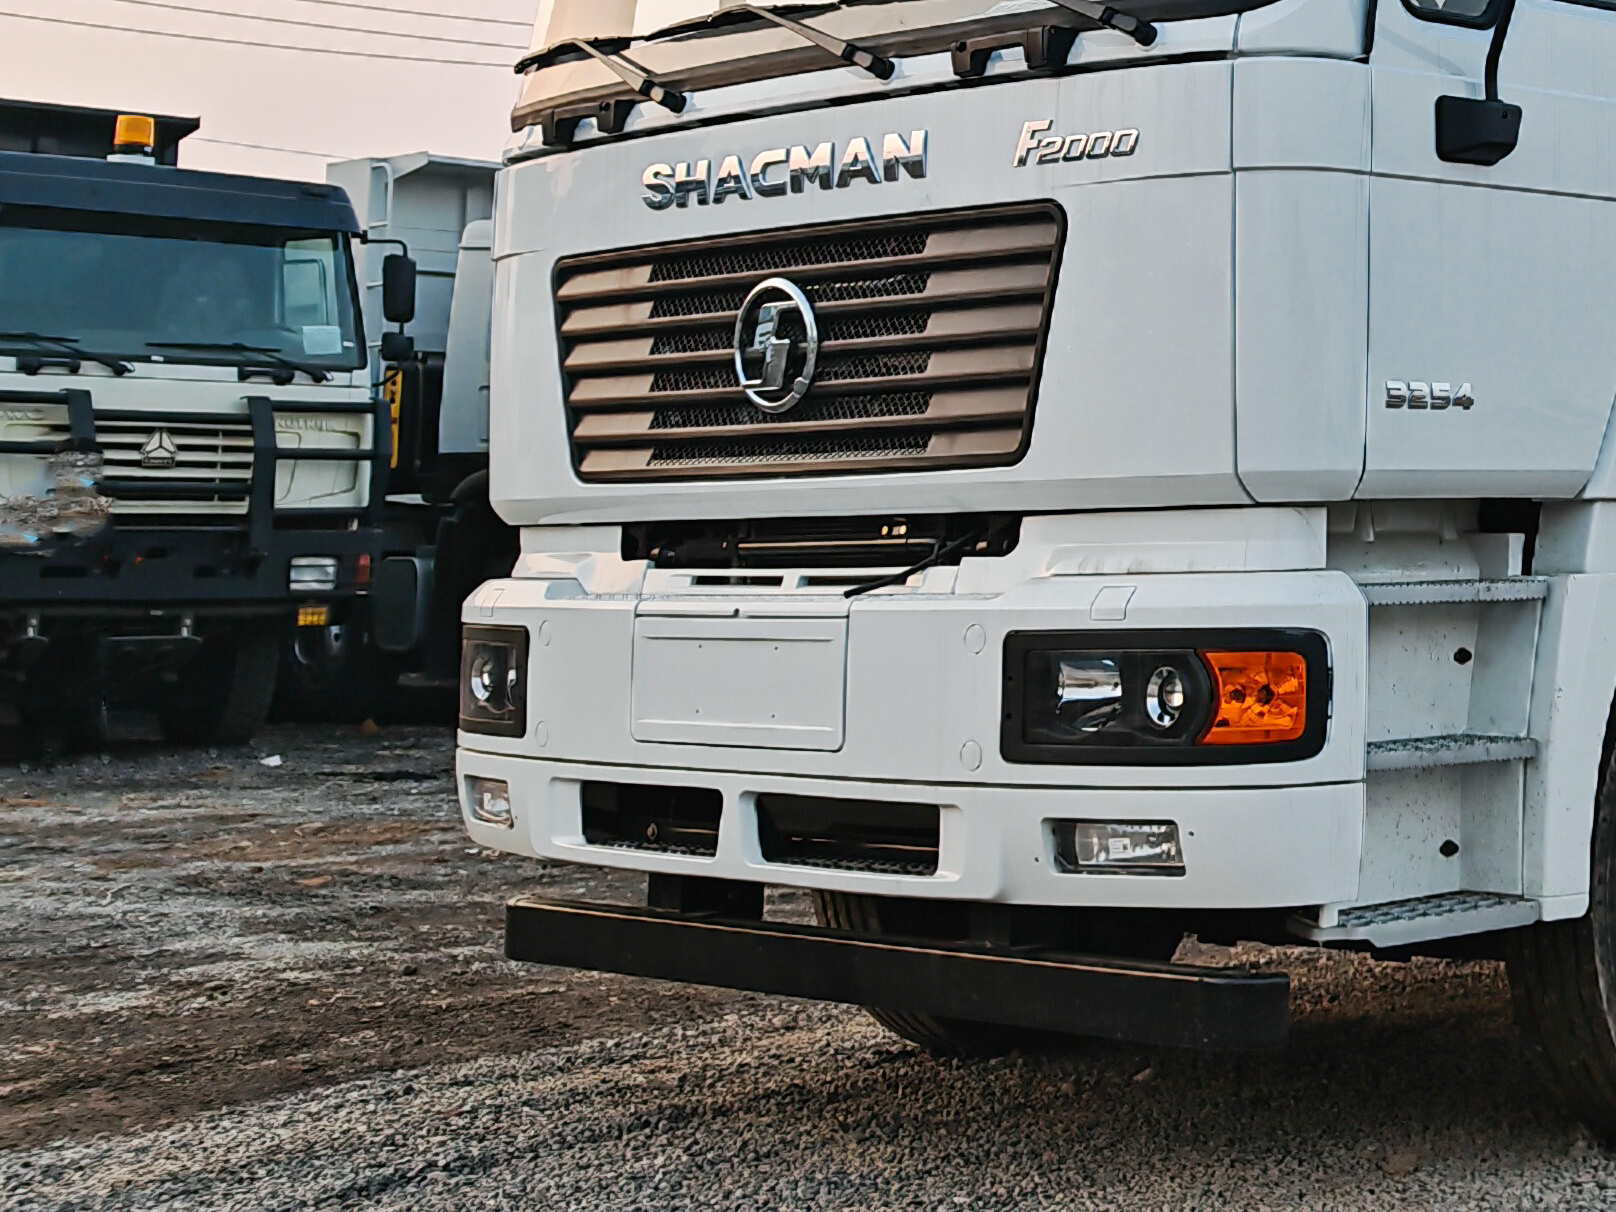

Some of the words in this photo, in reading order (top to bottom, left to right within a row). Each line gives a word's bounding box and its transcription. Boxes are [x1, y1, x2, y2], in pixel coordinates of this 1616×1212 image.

[1013, 119, 1140, 168] F2000
[641, 129, 928, 211] SHACMAN
[1385, 380, 1475, 410] 3254
